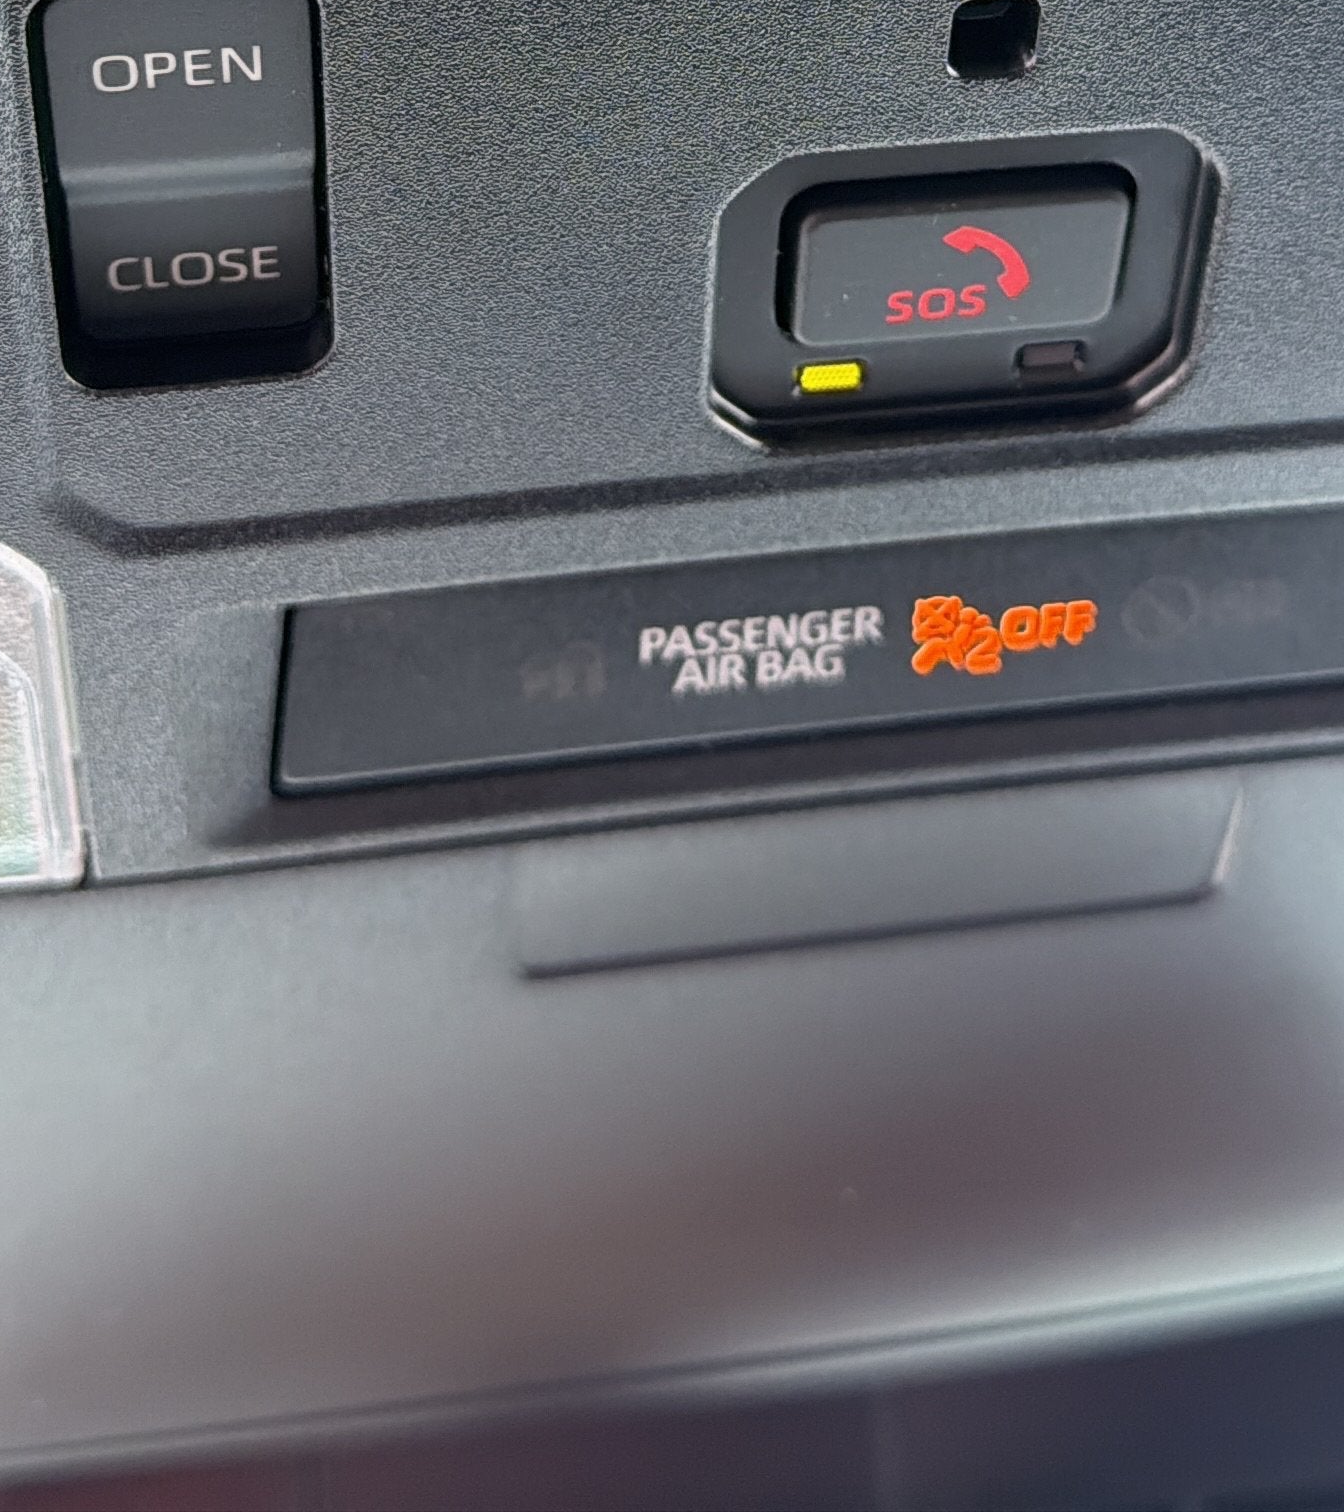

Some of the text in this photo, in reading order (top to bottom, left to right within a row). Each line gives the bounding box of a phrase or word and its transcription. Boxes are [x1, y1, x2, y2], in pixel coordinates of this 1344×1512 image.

[91, 45, 263, 94] OPEN
[108, 245, 281, 292] CLOSE
[885, 285, 987, 325] SOS
[639, 606, 885, 664] PASSENGER
[1000, 600, 1097, 652] OFF
[671, 643, 845, 695] AIR BAG
